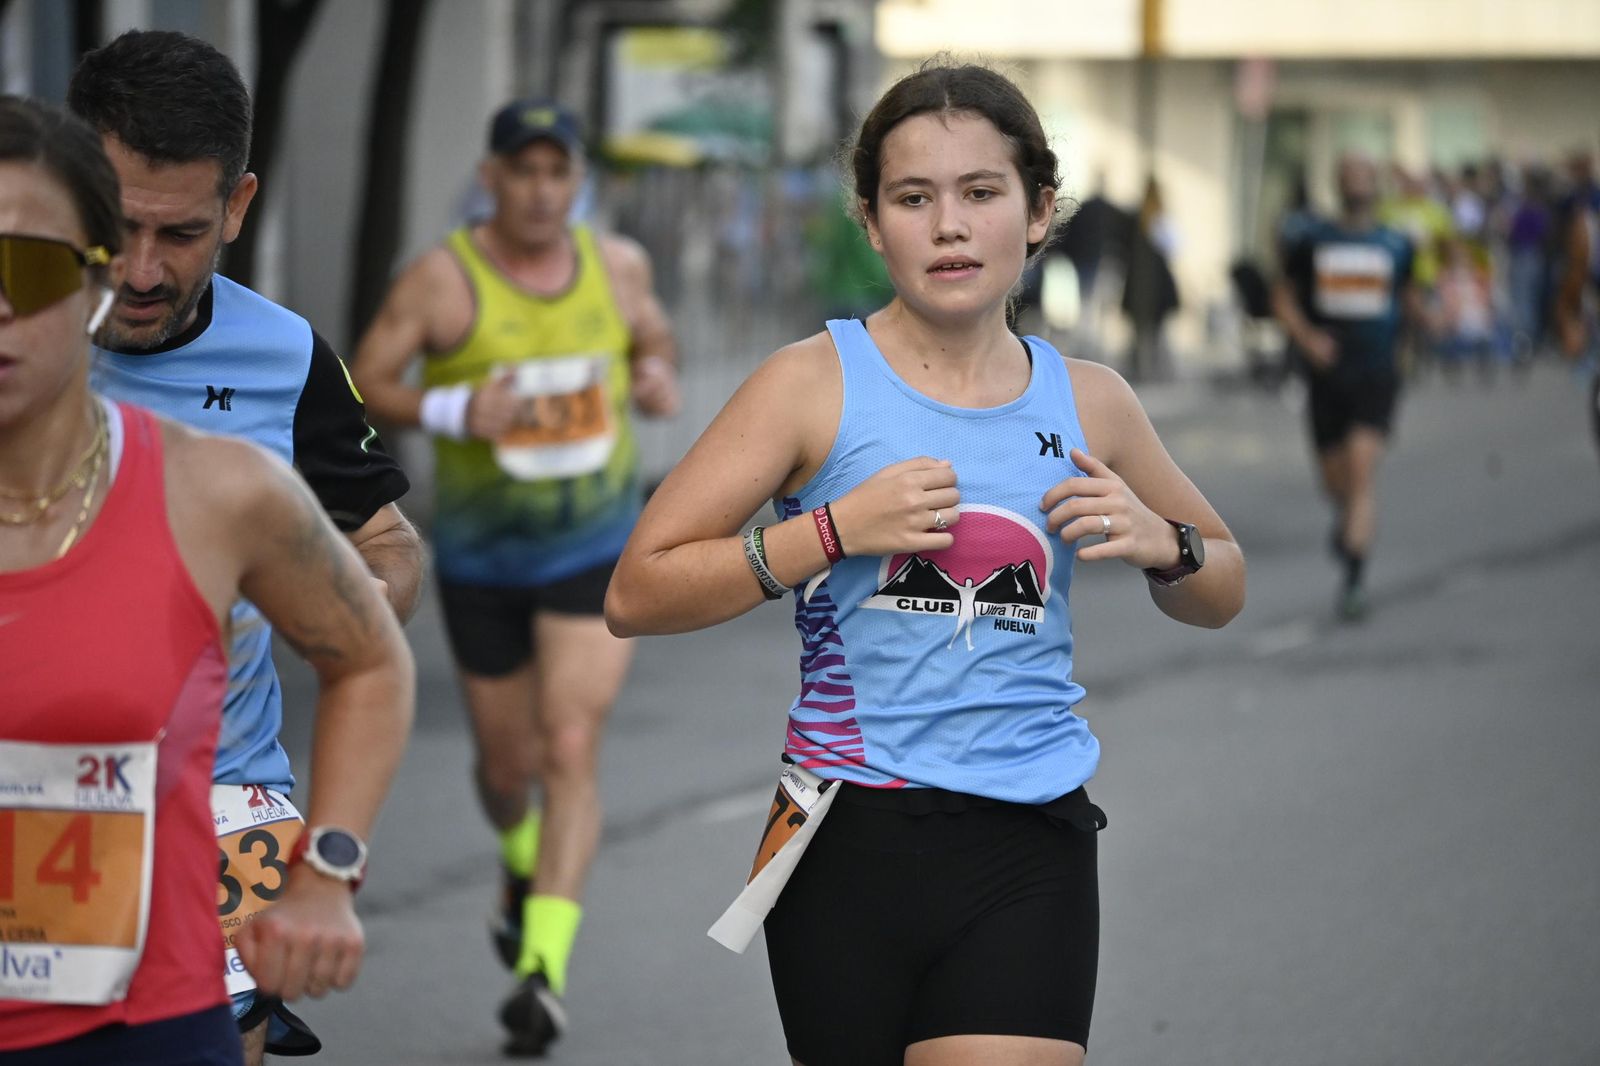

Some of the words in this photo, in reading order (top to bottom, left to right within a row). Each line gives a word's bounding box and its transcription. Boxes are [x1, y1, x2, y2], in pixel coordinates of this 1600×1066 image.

[818, 516, 835, 553] Derecho
[748, 553, 778, 591] SONRISA
[896, 598, 955, 614] CLUB
[979, 603, 1006, 617] Ultra
[1011, 604, 1038, 621] Trail
[993, 618, 1037, 636] HUELVA
[251, 806, 291, 823] HUELVA
